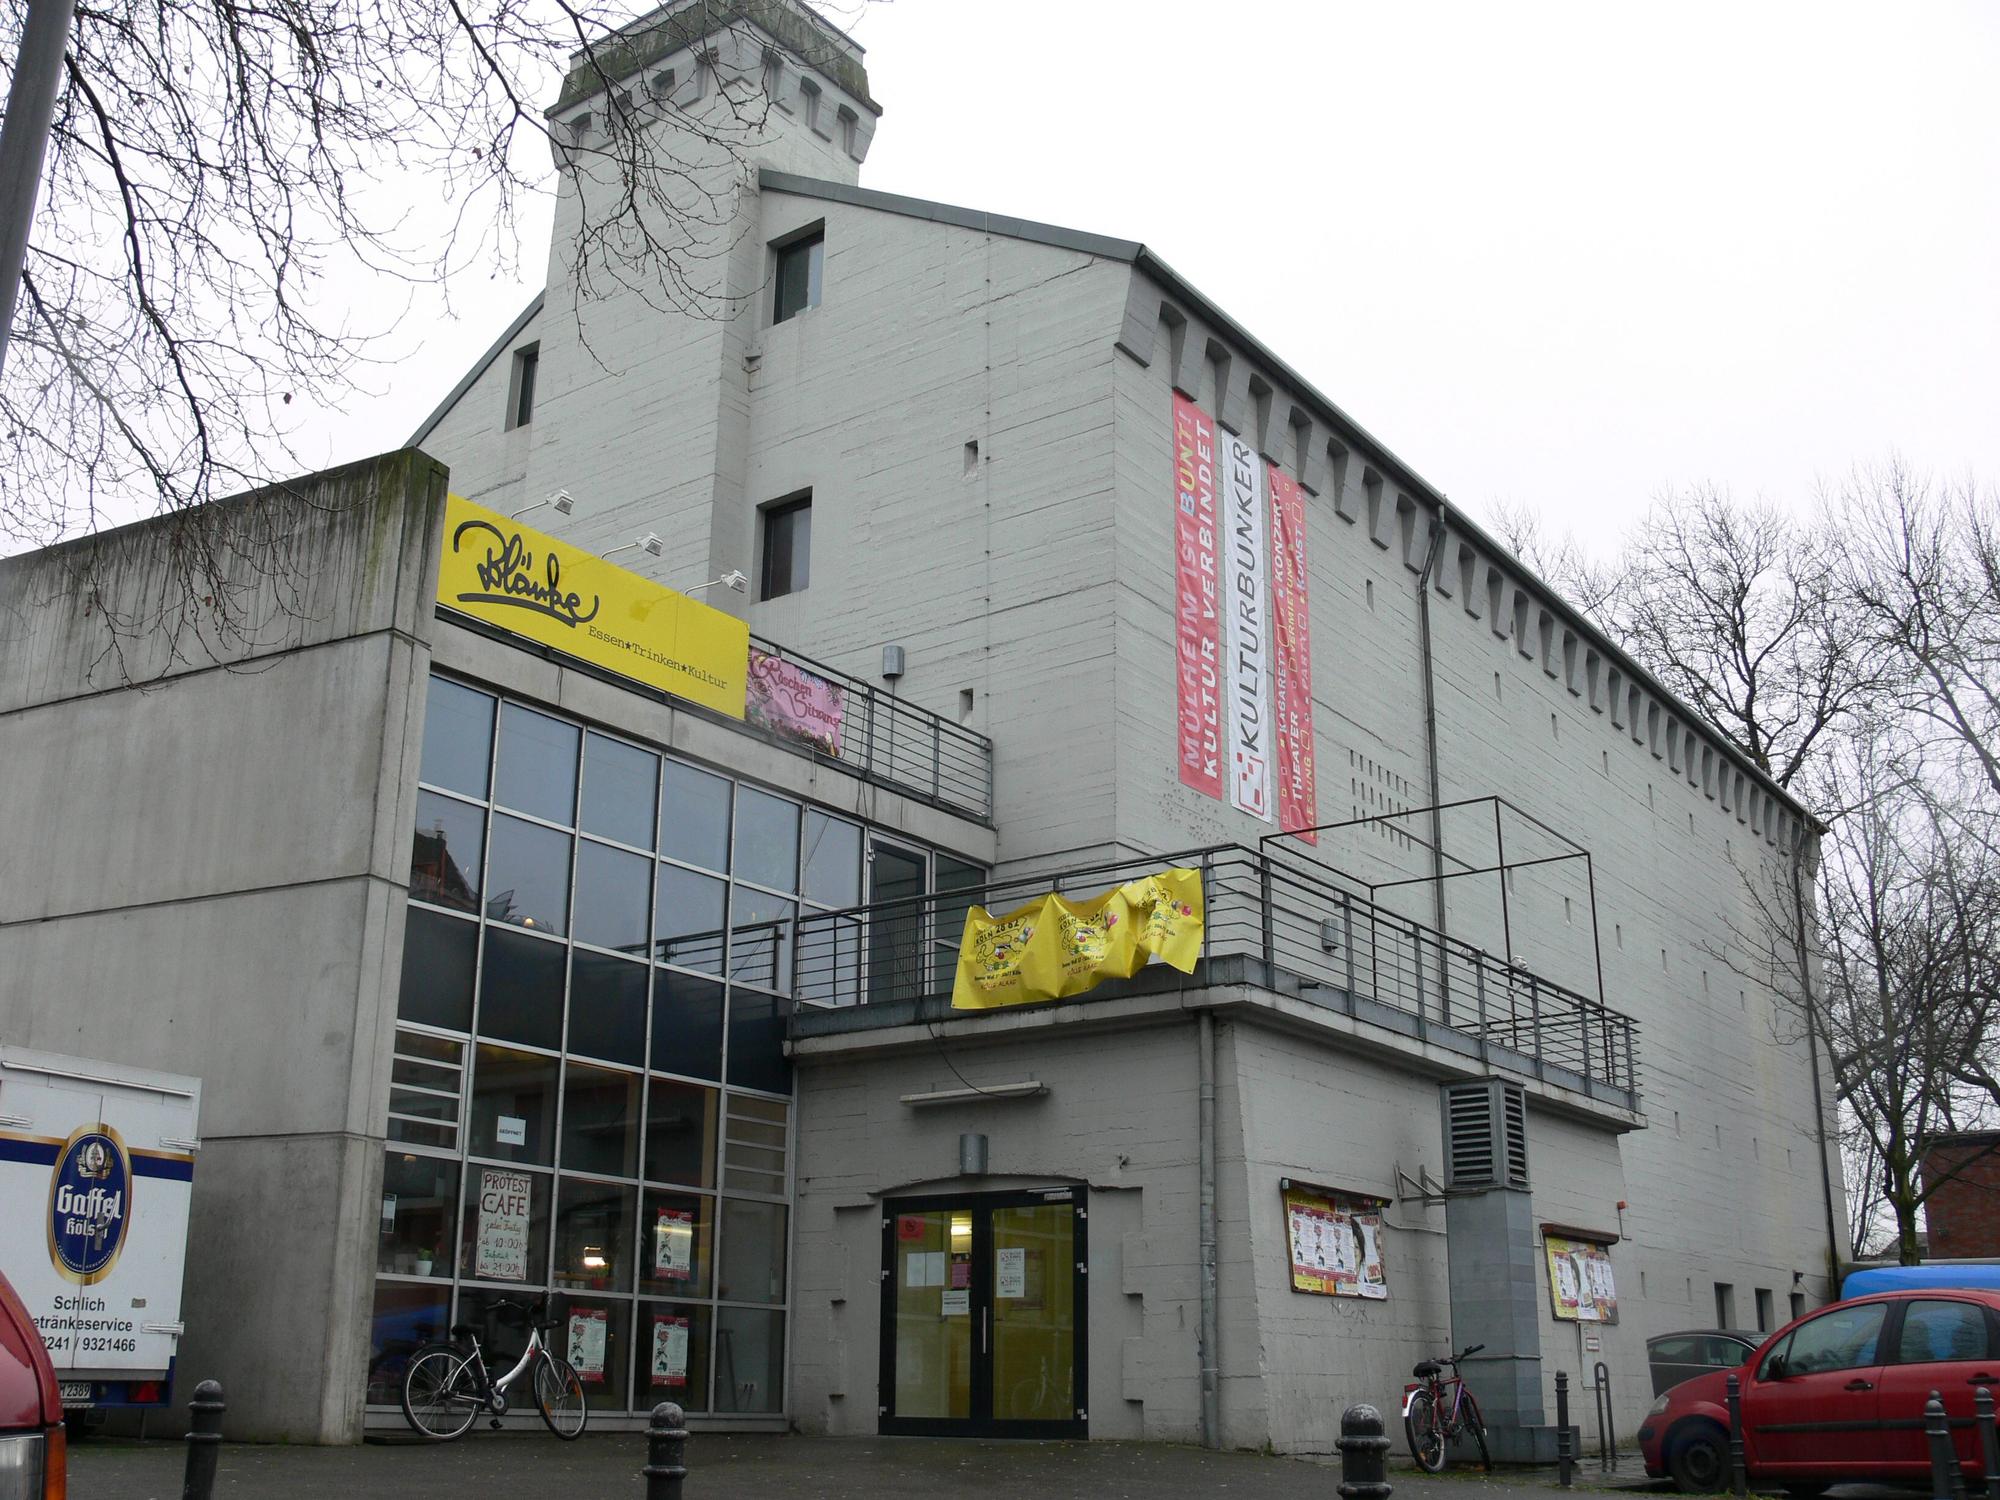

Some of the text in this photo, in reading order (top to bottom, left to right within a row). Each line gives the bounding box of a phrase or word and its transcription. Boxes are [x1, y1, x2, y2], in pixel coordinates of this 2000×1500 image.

[1272, 491, 1285, 584] KONZERT
[1179, 410, 1201, 770] MÜLHEIM IST BUNT!
[1197, 419, 1219, 779] KULTUR VERBINDET
[1234, 441, 1260, 753] KULTURBUNKER
[588, 625, 728, 690] Essen Trinken Kultur
[1286, 558, 1303, 800] THEATER VERMIETUNG
[1295, 526, 1314, 826] LESUNG PARTY KUNST
[57, 1184, 122, 1219] Gaffel
[481, 1193, 527, 1217] CAFE
[483, 1173, 531, 1194] PROTEST
[65, 1217, 109, 1239] Köls
[33, 1315, 133, 1332] etränkeservice
[53, 1296, 106, 1311] Schlich
[82, 1337, 136, 1352] 9321466
